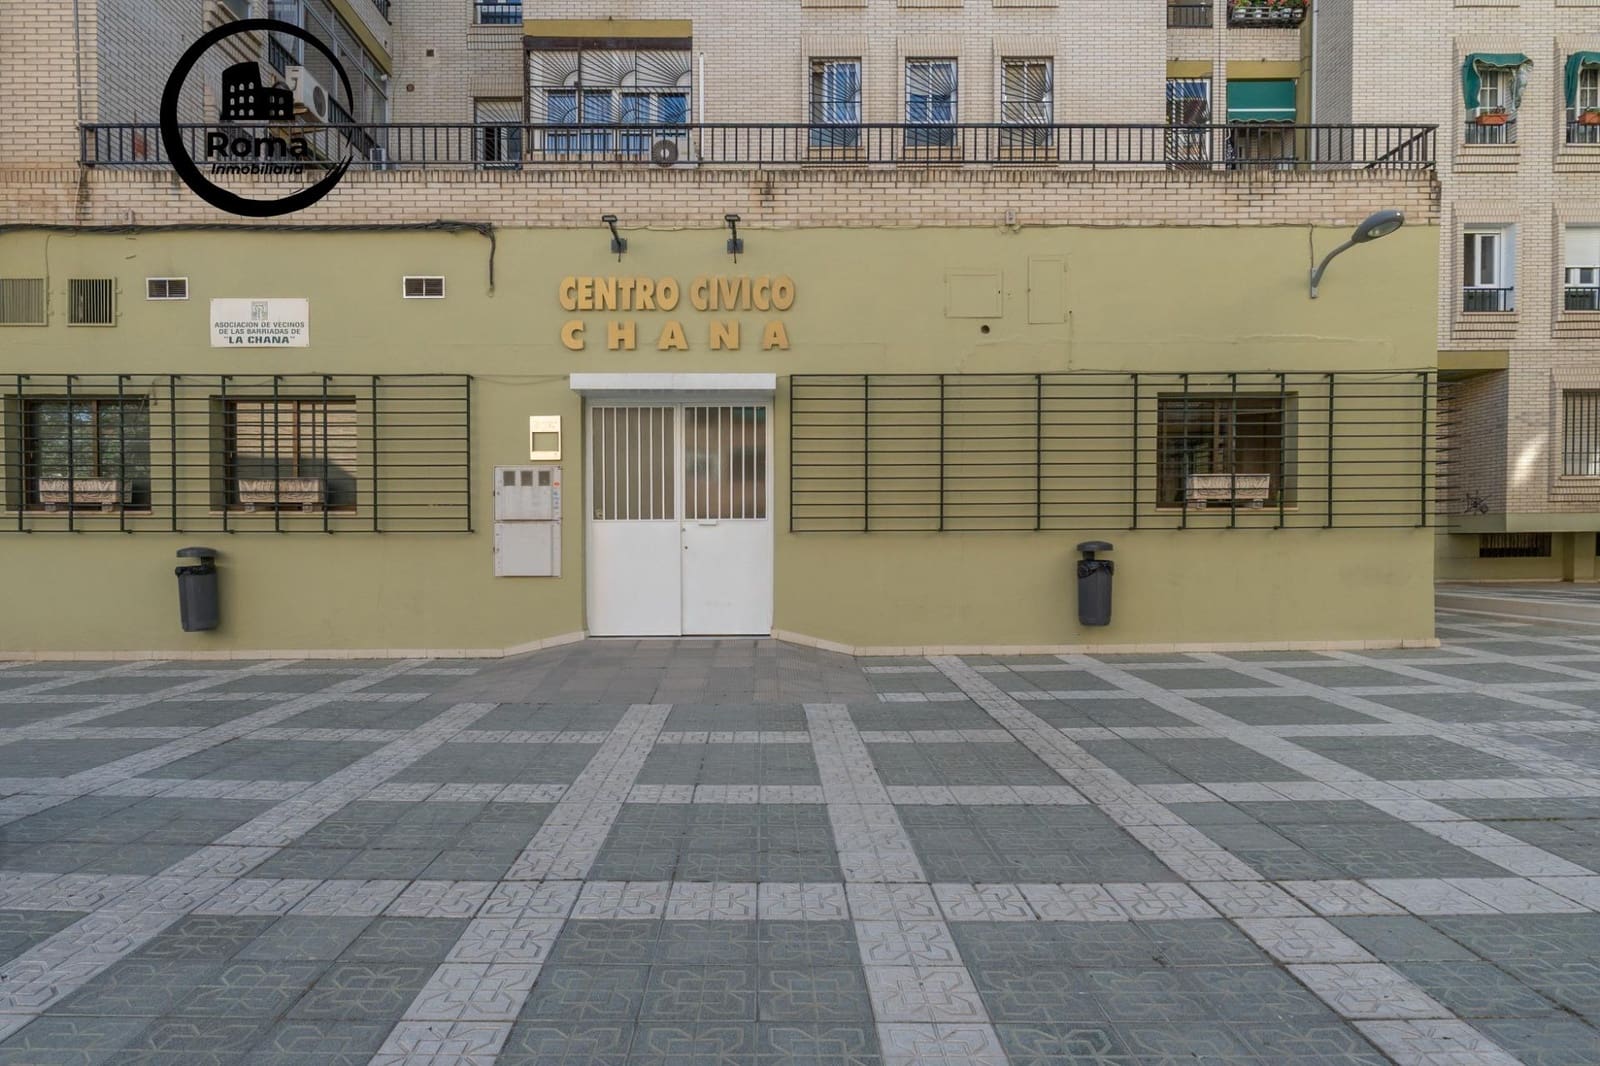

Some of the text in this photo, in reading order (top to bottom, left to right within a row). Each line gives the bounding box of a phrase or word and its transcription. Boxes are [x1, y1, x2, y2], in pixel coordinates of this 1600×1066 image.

[559, 276, 795, 311] CENTRO CIVICO
[560, 319, 790, 351] CHANA
